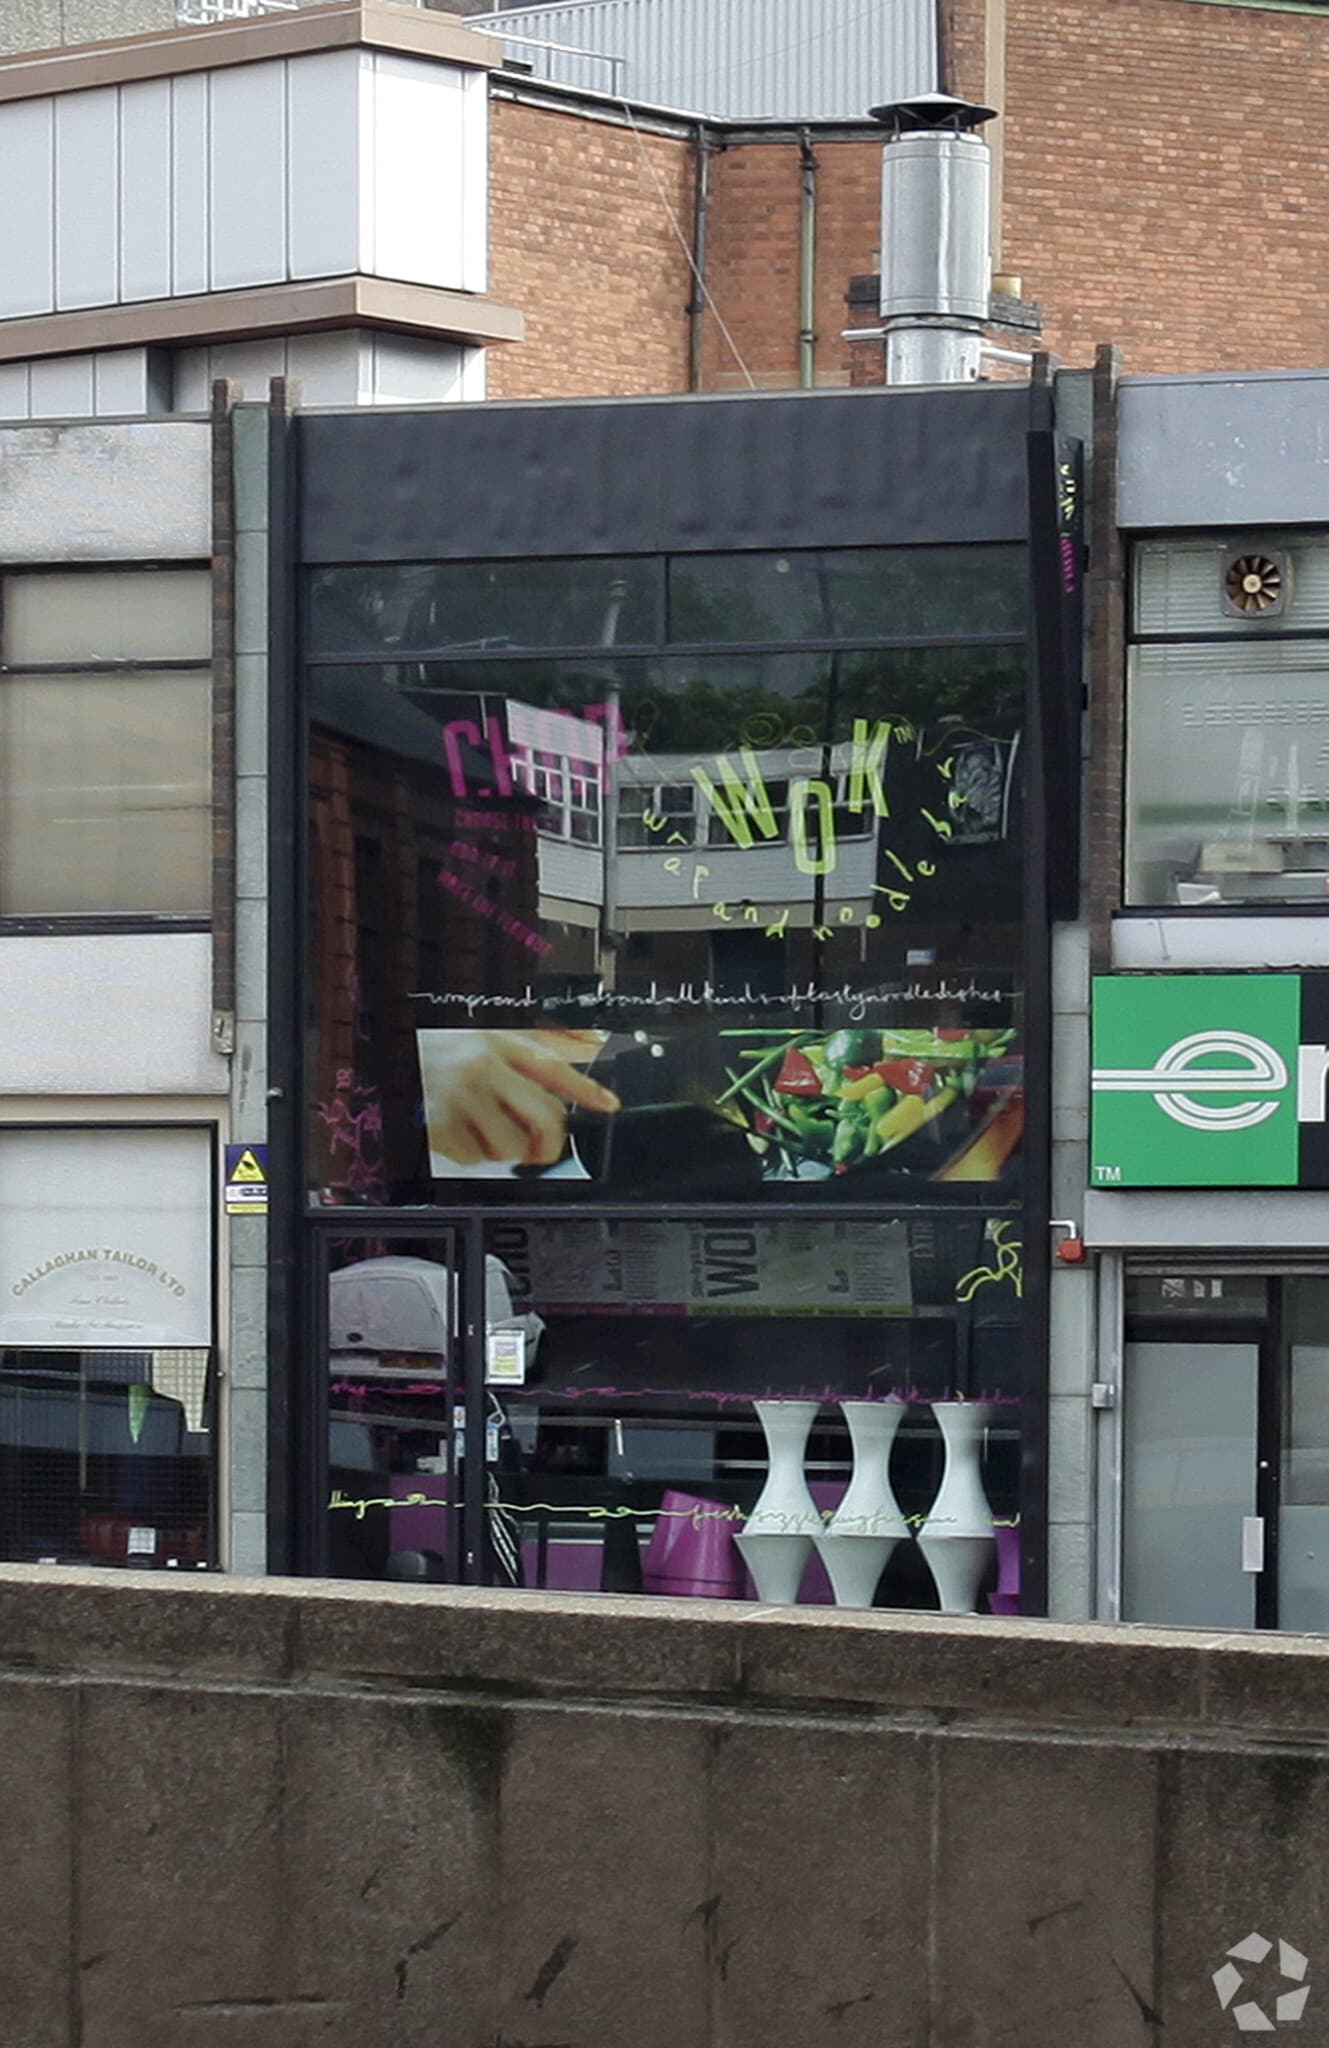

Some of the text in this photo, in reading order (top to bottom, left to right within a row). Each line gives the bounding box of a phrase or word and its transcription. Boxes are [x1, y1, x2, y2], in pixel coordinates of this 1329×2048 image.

[690, 717, 890, 875] WOK
[712, 901, 789, 939] and
[1096, 1166, 1121, 1182] TM
[12, 1249, 186, 1297] CALLAGHAN TAILOR LTD
